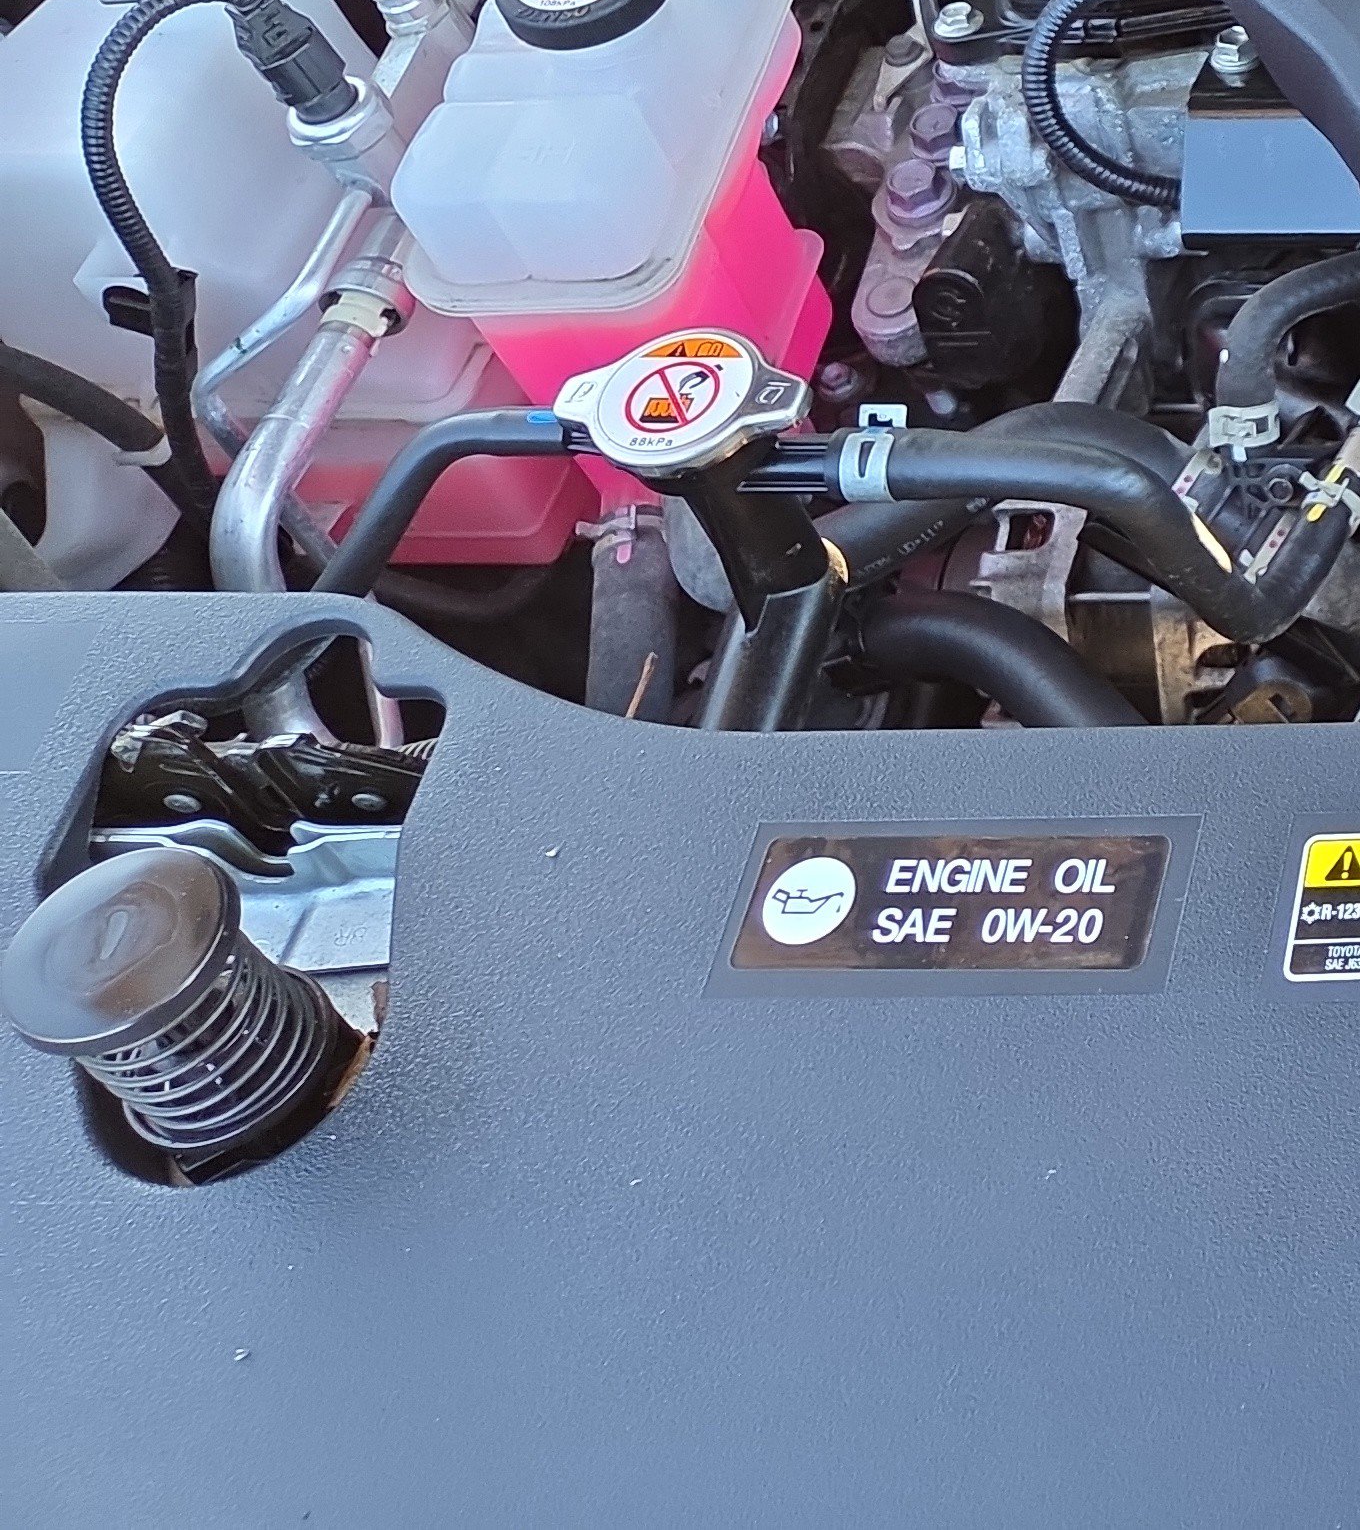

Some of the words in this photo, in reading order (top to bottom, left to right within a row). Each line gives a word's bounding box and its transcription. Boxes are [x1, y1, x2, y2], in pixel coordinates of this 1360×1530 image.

[629, 437, 674, 448] 88kPa
[885, 858, 1033, 894] ENGINE
[1053, 858, 1117, 894] OIL
[872, 908, 958, 945] SAE
[980, 908, 1104, 945] 0W-20
[1324, 958, 1346, 971] SAE
